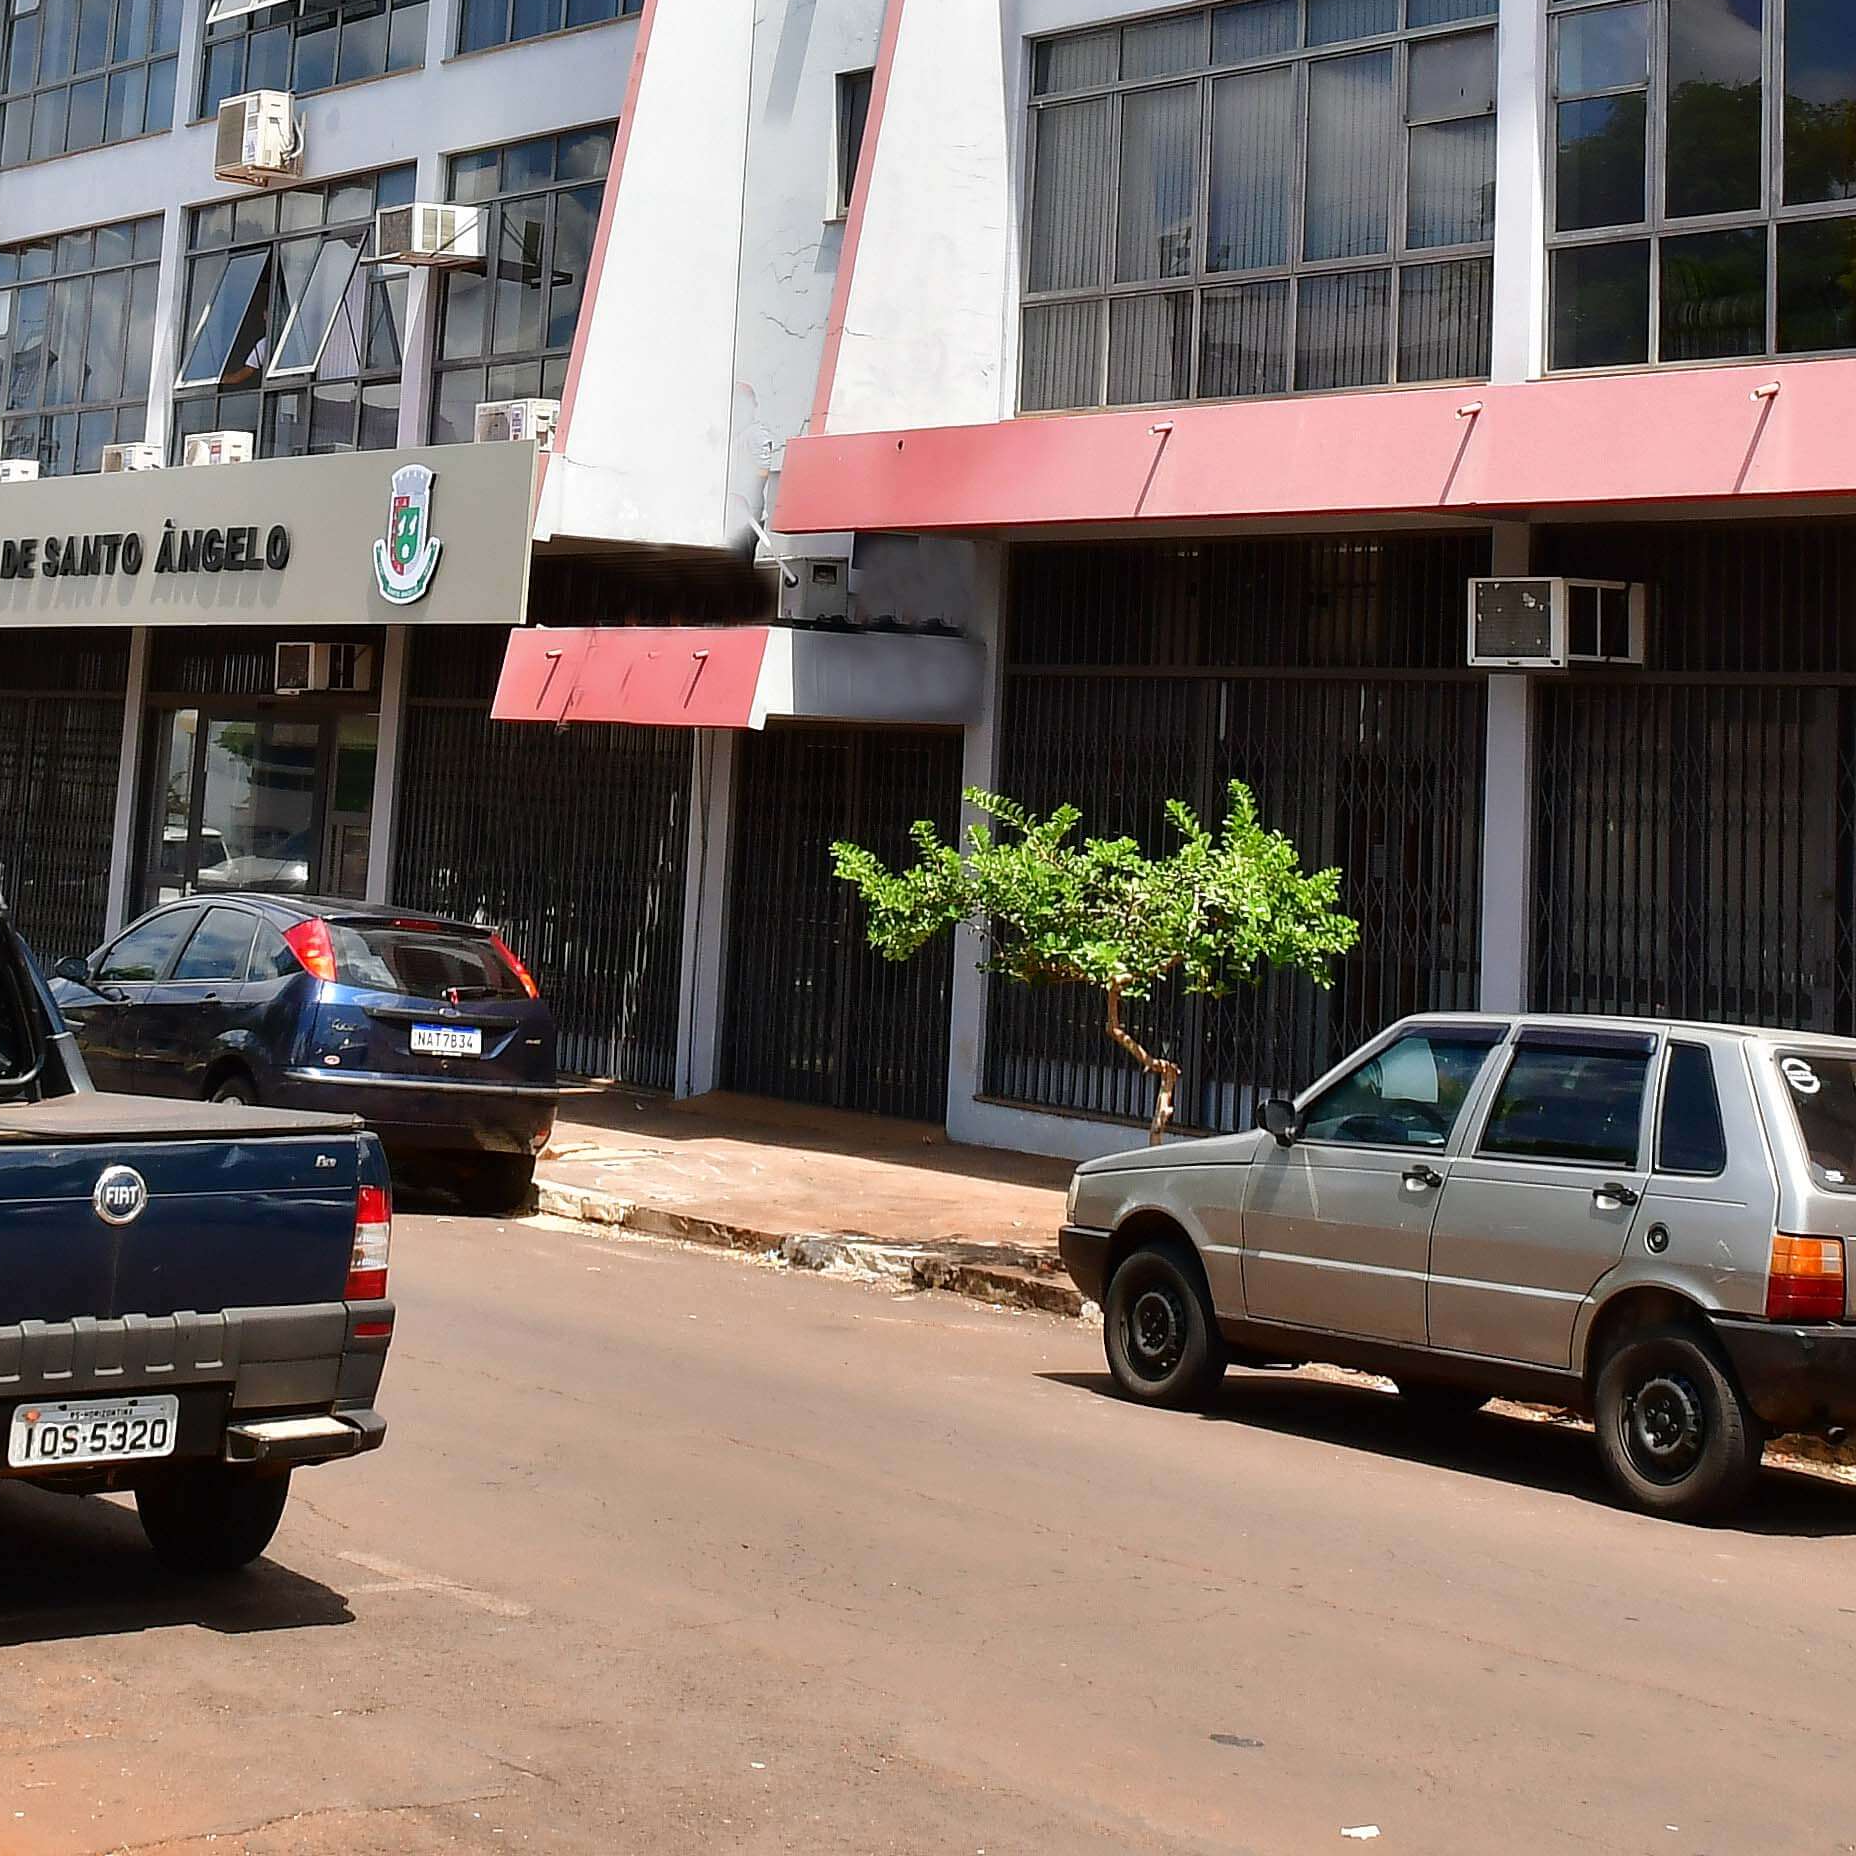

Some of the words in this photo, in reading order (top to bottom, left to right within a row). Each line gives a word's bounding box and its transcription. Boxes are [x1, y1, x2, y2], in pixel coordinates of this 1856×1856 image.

[0, 537, 39, 580] DE
[42, 531, 144, 578] SANTO
[153, 517, 291, 574] ÂNGELO
[417, 1030, 474, 1050] NAT7B34
[105, 1185, 140, 1205] FIAT
